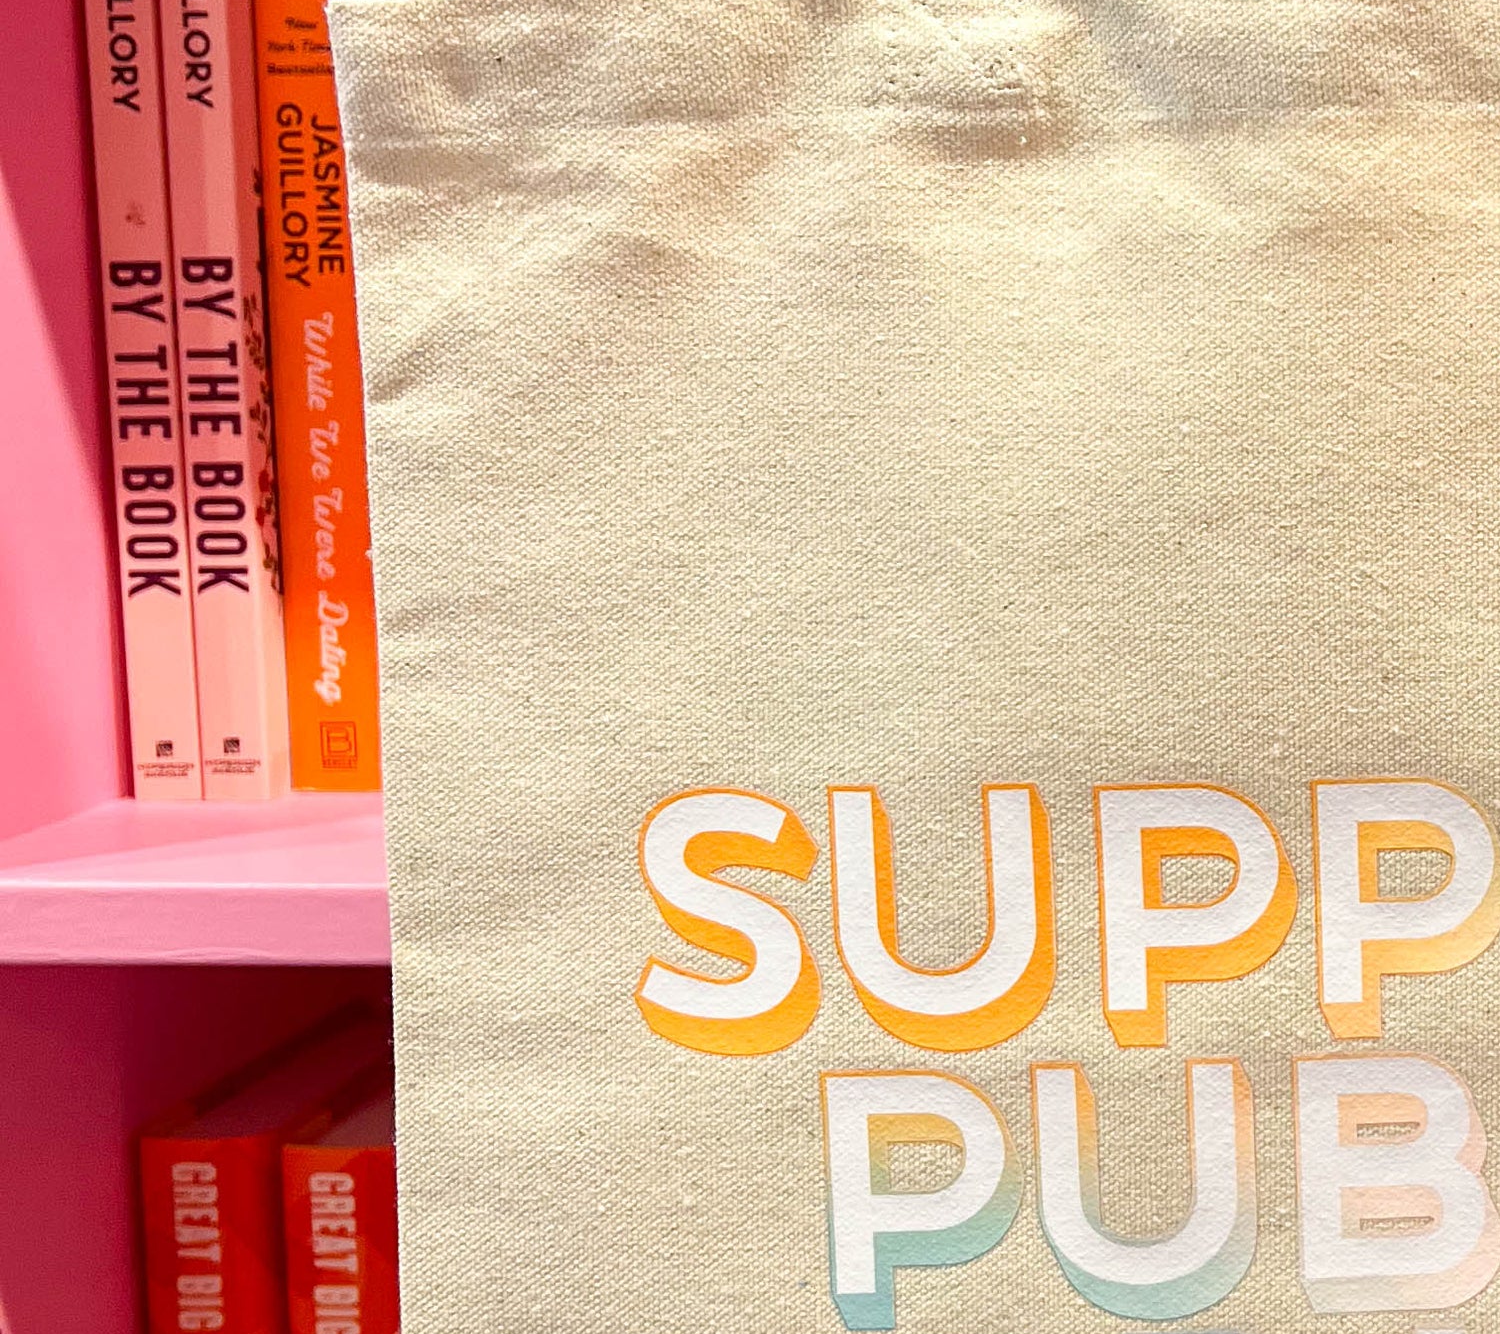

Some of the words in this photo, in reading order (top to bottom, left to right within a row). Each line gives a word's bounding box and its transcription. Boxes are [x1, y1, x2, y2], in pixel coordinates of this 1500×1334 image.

[276, 103, 310, 288] GUILLORY
[311, 115, 344, 274] JASMINE
[109, 260, 166, 324] BY
[182, 256, 237, 320] BY
[114, 345, 172, 439] THE
[186, 341, 242, 436] THE
[304, 312, 334, 412] While
[310, 420, 339, 482] We
[123, 465, 181, 597] BOOK
[192, 461, 249, 594] BOOK
[314, 487, 343, 580] Were
[314, 592, 349, 705] Dating
[172, 1162, 221, 1264] GREAT
[308, 1171, 358, 1274] GREAT
[177, 1274, 223, 1331] BIG
